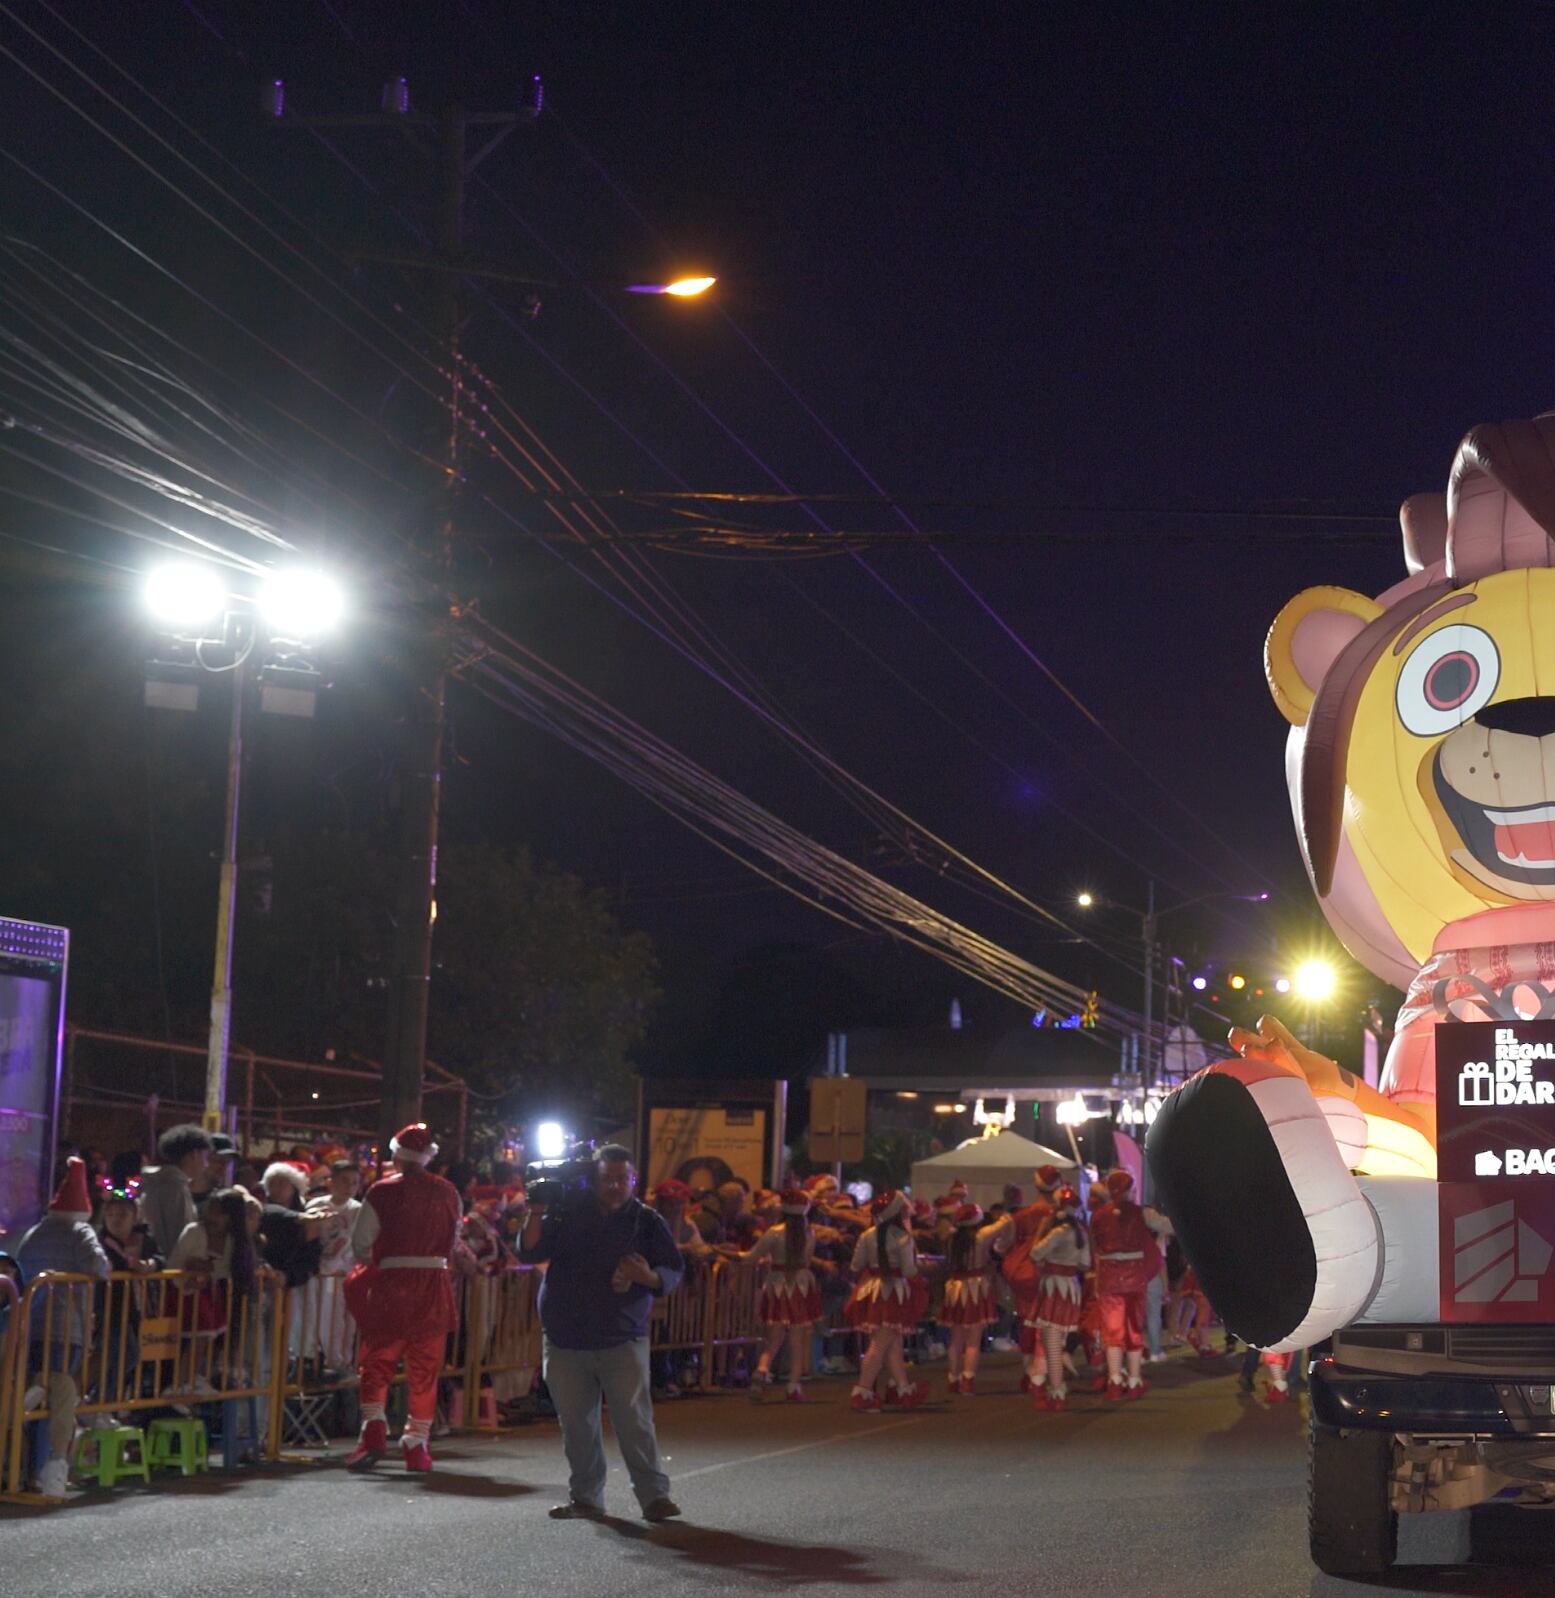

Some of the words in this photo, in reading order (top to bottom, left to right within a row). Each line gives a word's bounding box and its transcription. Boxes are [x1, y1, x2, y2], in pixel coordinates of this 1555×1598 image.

[1495, 1028, 1519, 1044] EL
[1495, 1059, 1533, 1082] DE
[1496, 1081, 1555, 1105] DAR
